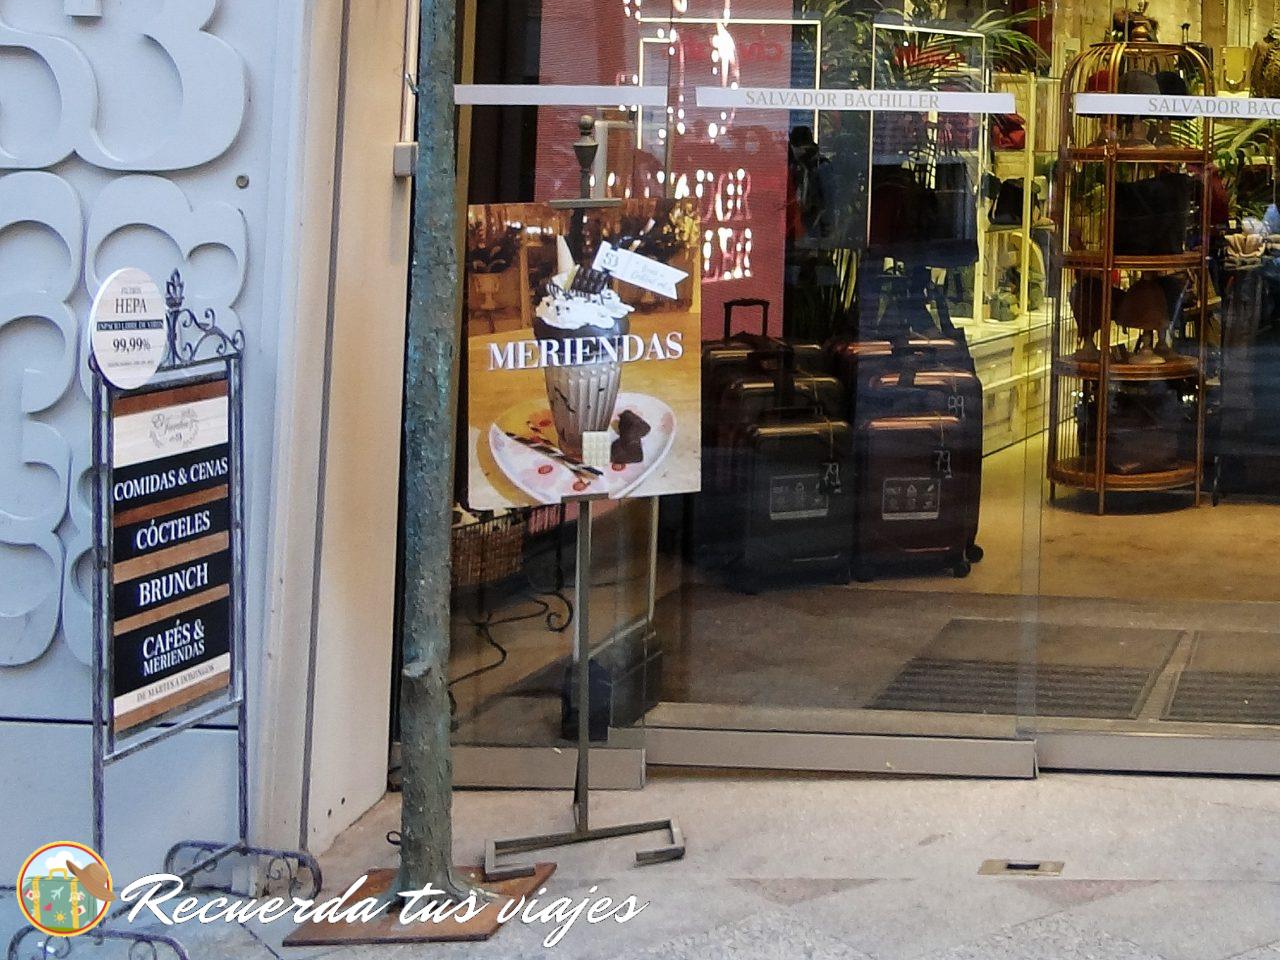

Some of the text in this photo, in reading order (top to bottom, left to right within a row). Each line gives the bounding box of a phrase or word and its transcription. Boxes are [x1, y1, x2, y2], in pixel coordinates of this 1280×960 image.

[745, 91, 941, 109] SALVADOR BACHILLER
[1148, 97, 1241, 115] SALVADOR
[115, 297, 147, 314] HEPA
[487, 331, 684, 371] MERIENDAS
[114, 457, 229, 501] COMIDAS & CENAS
[135, 510, 211, 550] CÓCTELES
[139, 562, 209, 606] BRUNCH
[143, 619, 205, 659] CAFÉS &
[143, 639, 205, 677] MERIENDAS
